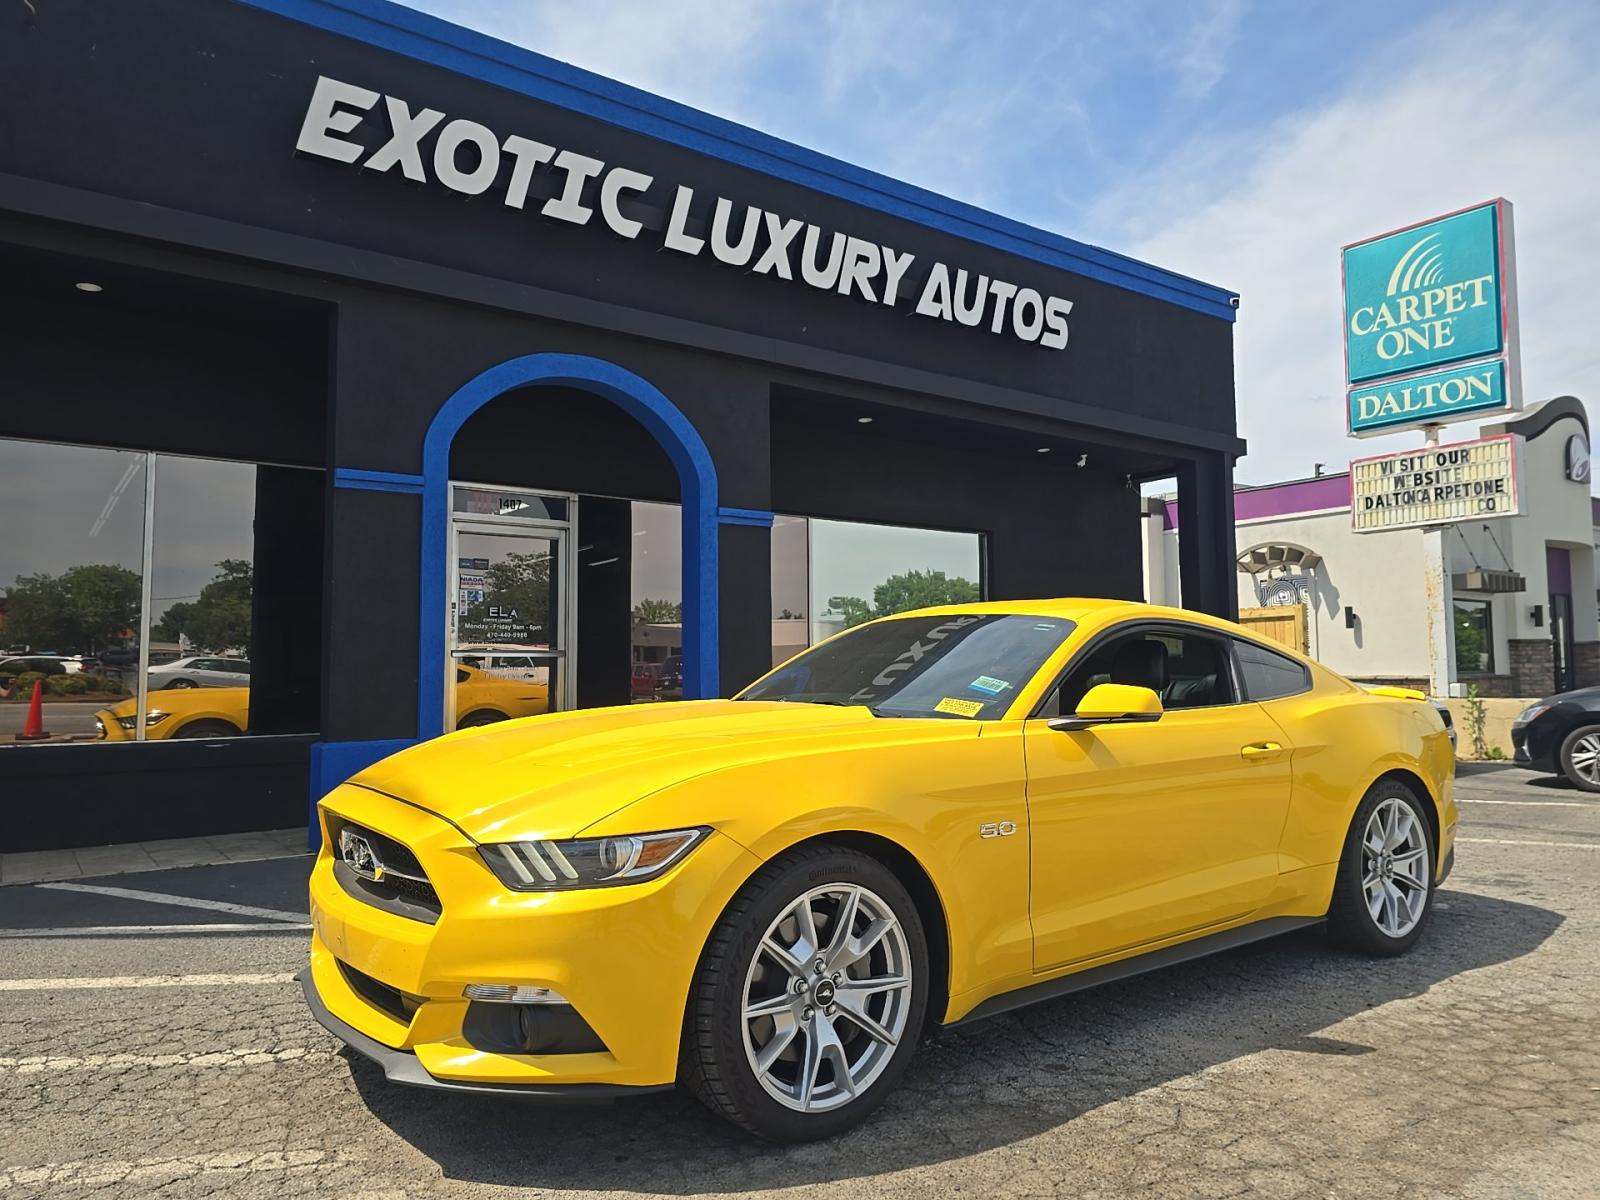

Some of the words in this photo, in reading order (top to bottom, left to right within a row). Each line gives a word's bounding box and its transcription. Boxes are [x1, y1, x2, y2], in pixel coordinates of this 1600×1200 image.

[296, 75, 654, 239] EXOTIC
[664, 184, 915, 307] LUXURY
[915, 262, 1074, 351] AUTOS
[1351, 275, 1493, 336] CARPET
[1376, 318, 1455, 360] ONE
[1357, 372, 1494, 421] DALTON
[1436, 450, 1470, 467] OUR
[499, 498, 522, 510] 1407
[464, 622, 488, 630] Monday
[493, 623, 512, 631] Friday
[489, 606, 518, 618] ELA
